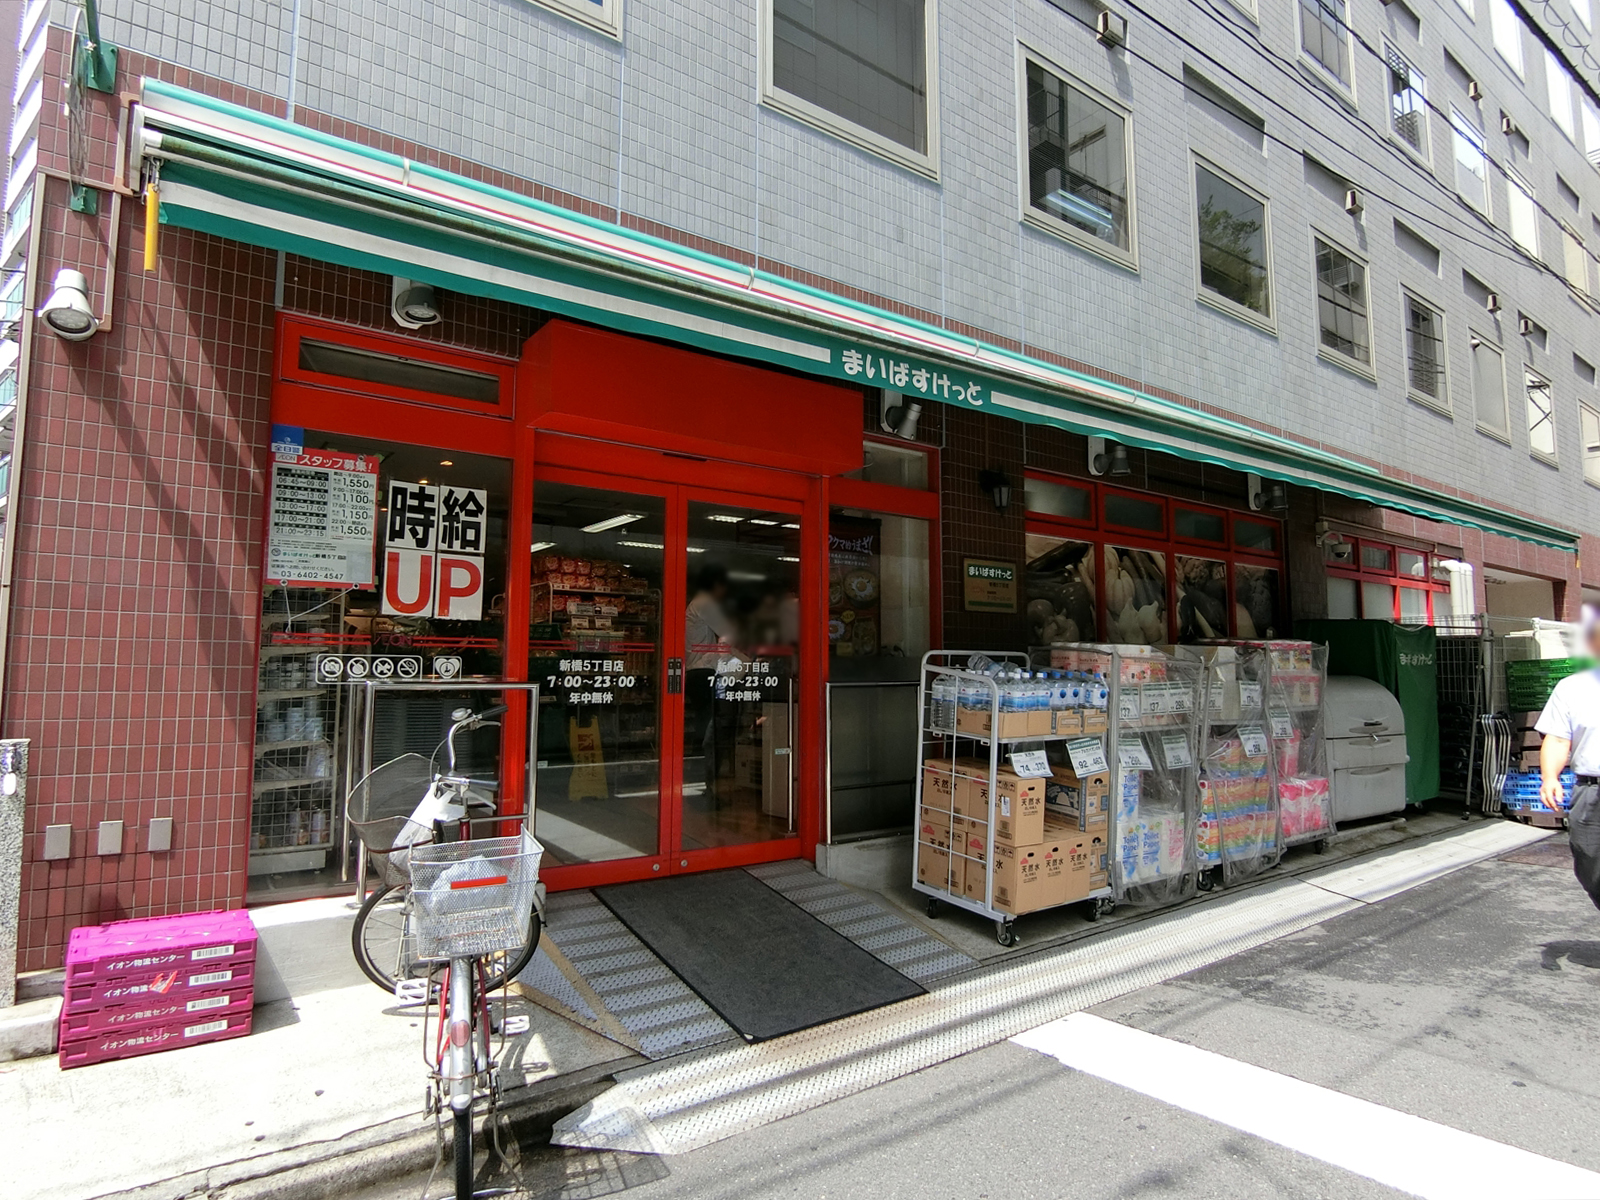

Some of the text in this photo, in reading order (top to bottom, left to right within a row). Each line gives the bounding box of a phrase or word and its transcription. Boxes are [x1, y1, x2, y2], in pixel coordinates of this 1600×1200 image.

[842, 350, 983, 406] まいばすけっと
[388, 485, 484, 551] 時給
[280, 570, 344, 580] 03-6402-4547
[968, 566, 1012, 580] まいばすけっと
[386, 551, 481, 617] UP
[559, 659, 625, 672] 新橋5丁目店
[547, 675, 635, 688] 7:00～23:00
[707, 676, 778, 687] 7:00～23:00
[569, 691, 614, 704] 年中無休
[725, 690, 761, 701] 年中無休
[1078, 760, 1089, 769] 92
[1021, 797, 1041, 806] 天然水
[1046, 858, 1064, 867] 天然水
[1070, 853, 1088, 862] 天然水
[1021, 864, 1041, 873] 天然水
[106, 954, 185, 971] イオン物流センター
[103, 981, 182, 998] イオン物流ー
[108, 1006, 185, 1023] イオン物流センター
[101, 1032, 179, 1050] イオン物流センター
